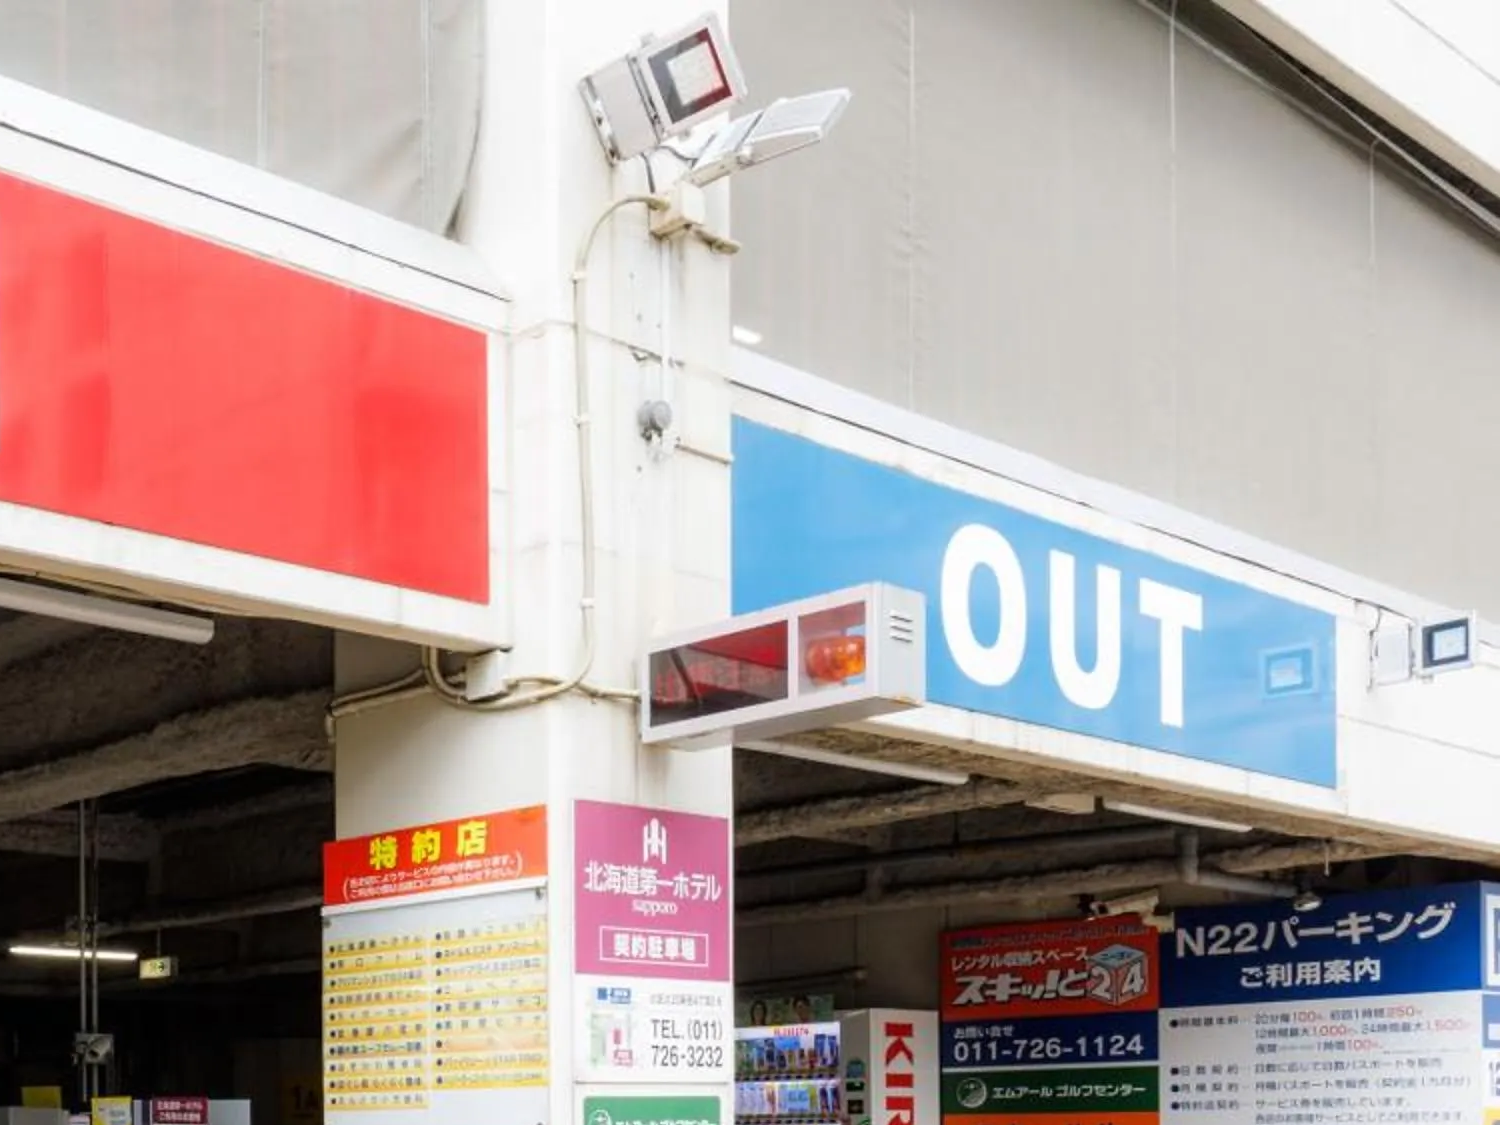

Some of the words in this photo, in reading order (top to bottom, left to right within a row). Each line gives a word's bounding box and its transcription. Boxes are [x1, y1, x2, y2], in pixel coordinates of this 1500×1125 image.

[941, 524, 1203, 728] OUT
[370, 821, 487, 870] 特約店
[584, 860, 721, 901] 北海道第一ホテル
[1176, 902, 1456, 957] N22パーキング
[613, 932, 695, 961] 契約駐車場
[952, 946, 1088, 971] レンタル収納スペース
[1240, 957, 1381, 988] ご利用案内
[651, 1045, 723, 1067] 726-3232
[954, 1034, 1144, 1062] 011-726-1124
[992, 1085, 1053, 1099] エムアール
[1055, 1082, 1147, 1098] ゴルフセンター
